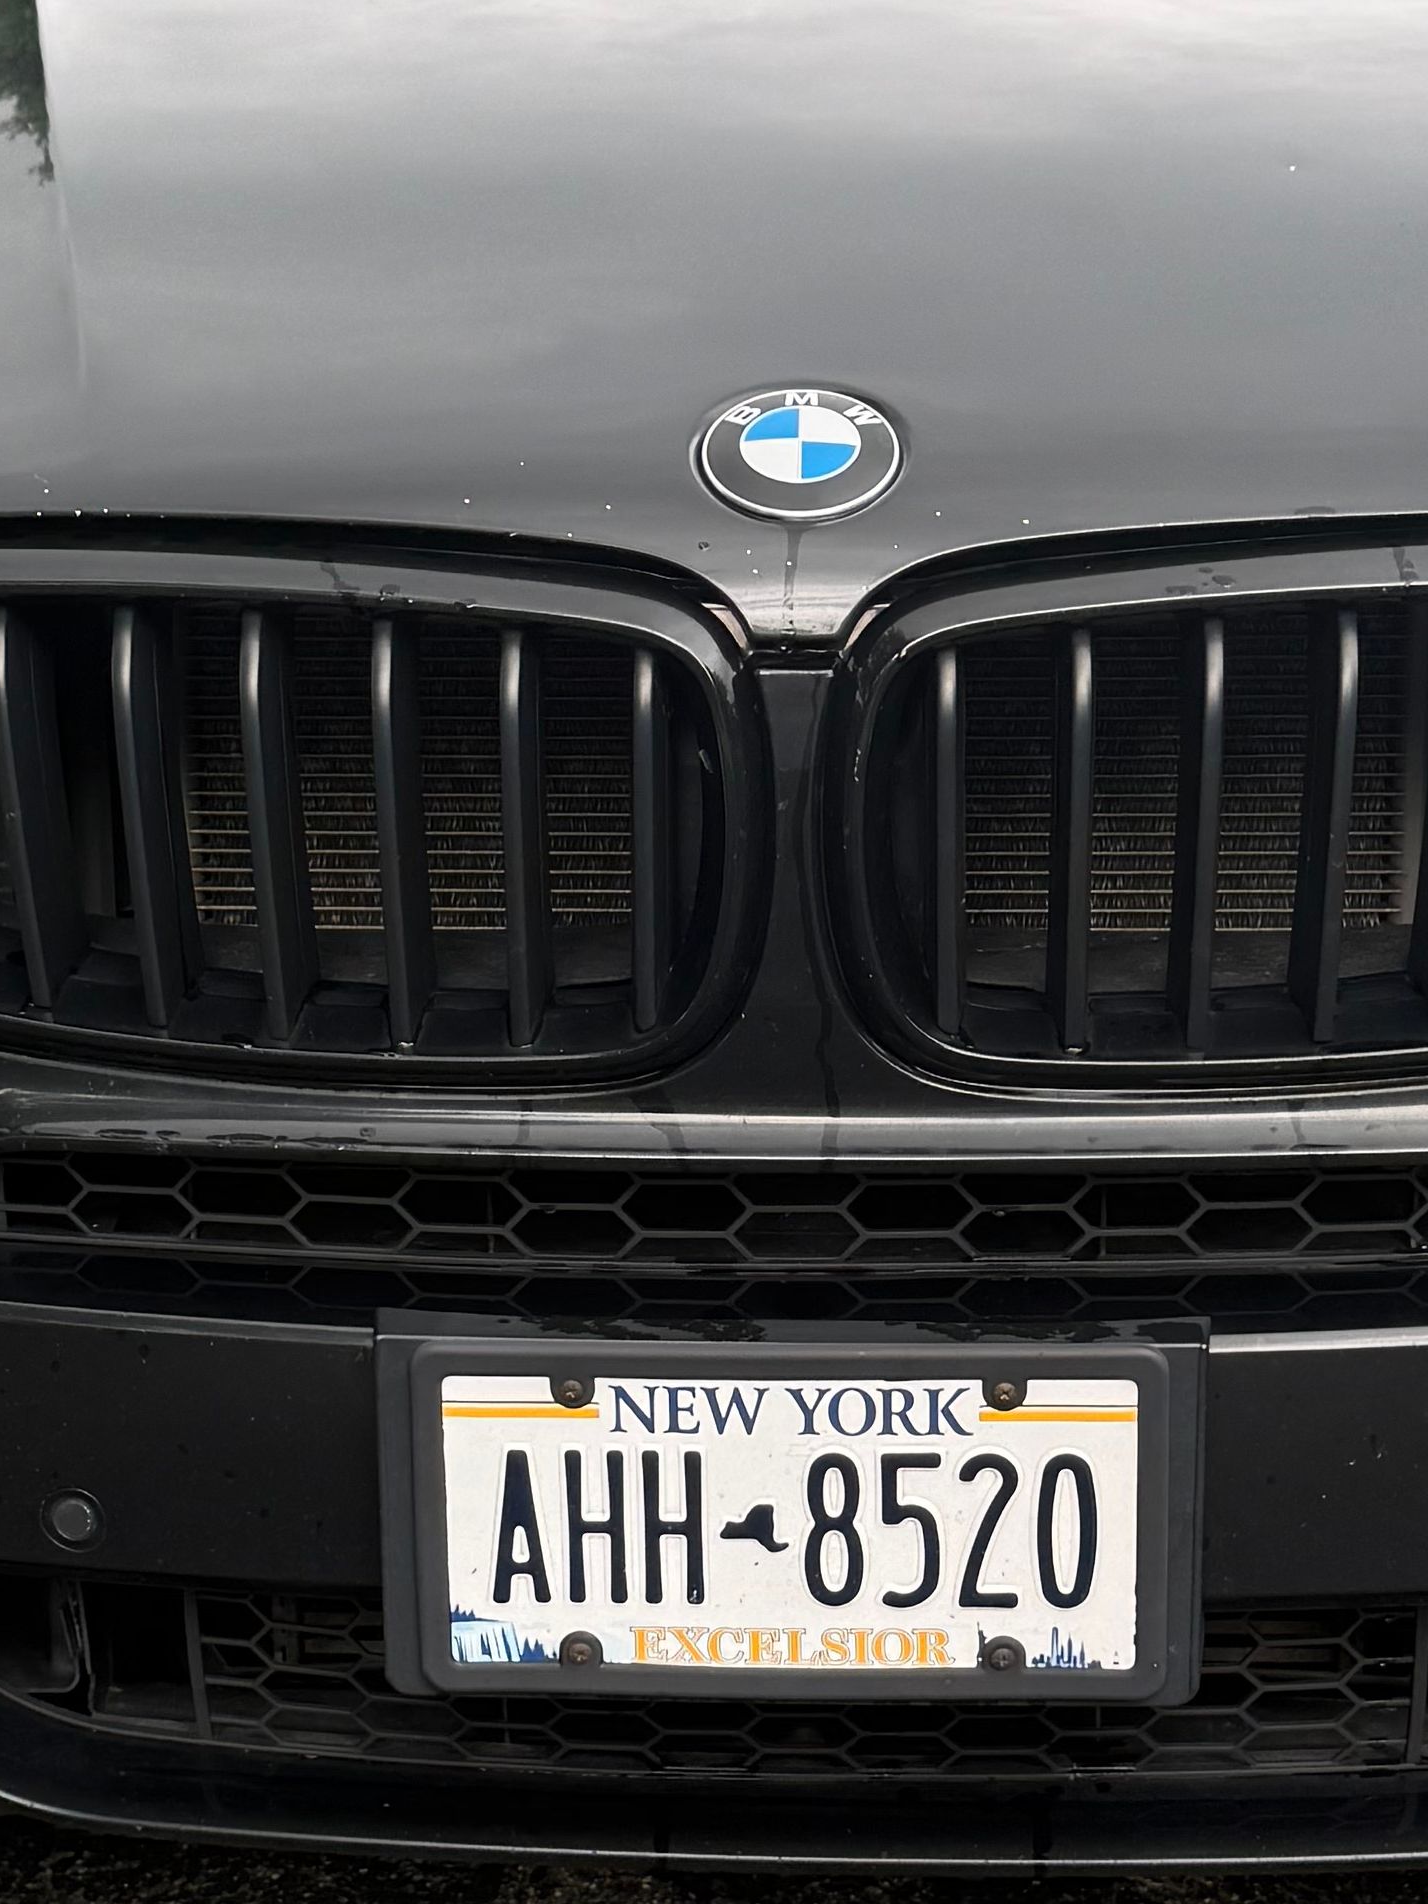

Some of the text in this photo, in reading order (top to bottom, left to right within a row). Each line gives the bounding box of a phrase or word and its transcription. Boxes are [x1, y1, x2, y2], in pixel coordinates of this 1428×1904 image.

[724, 392, 883, 426] BMW
[608, 1385, 974, 1437] NEW YORK
[629, 1626, 955, 1666] EXCELSIOR
